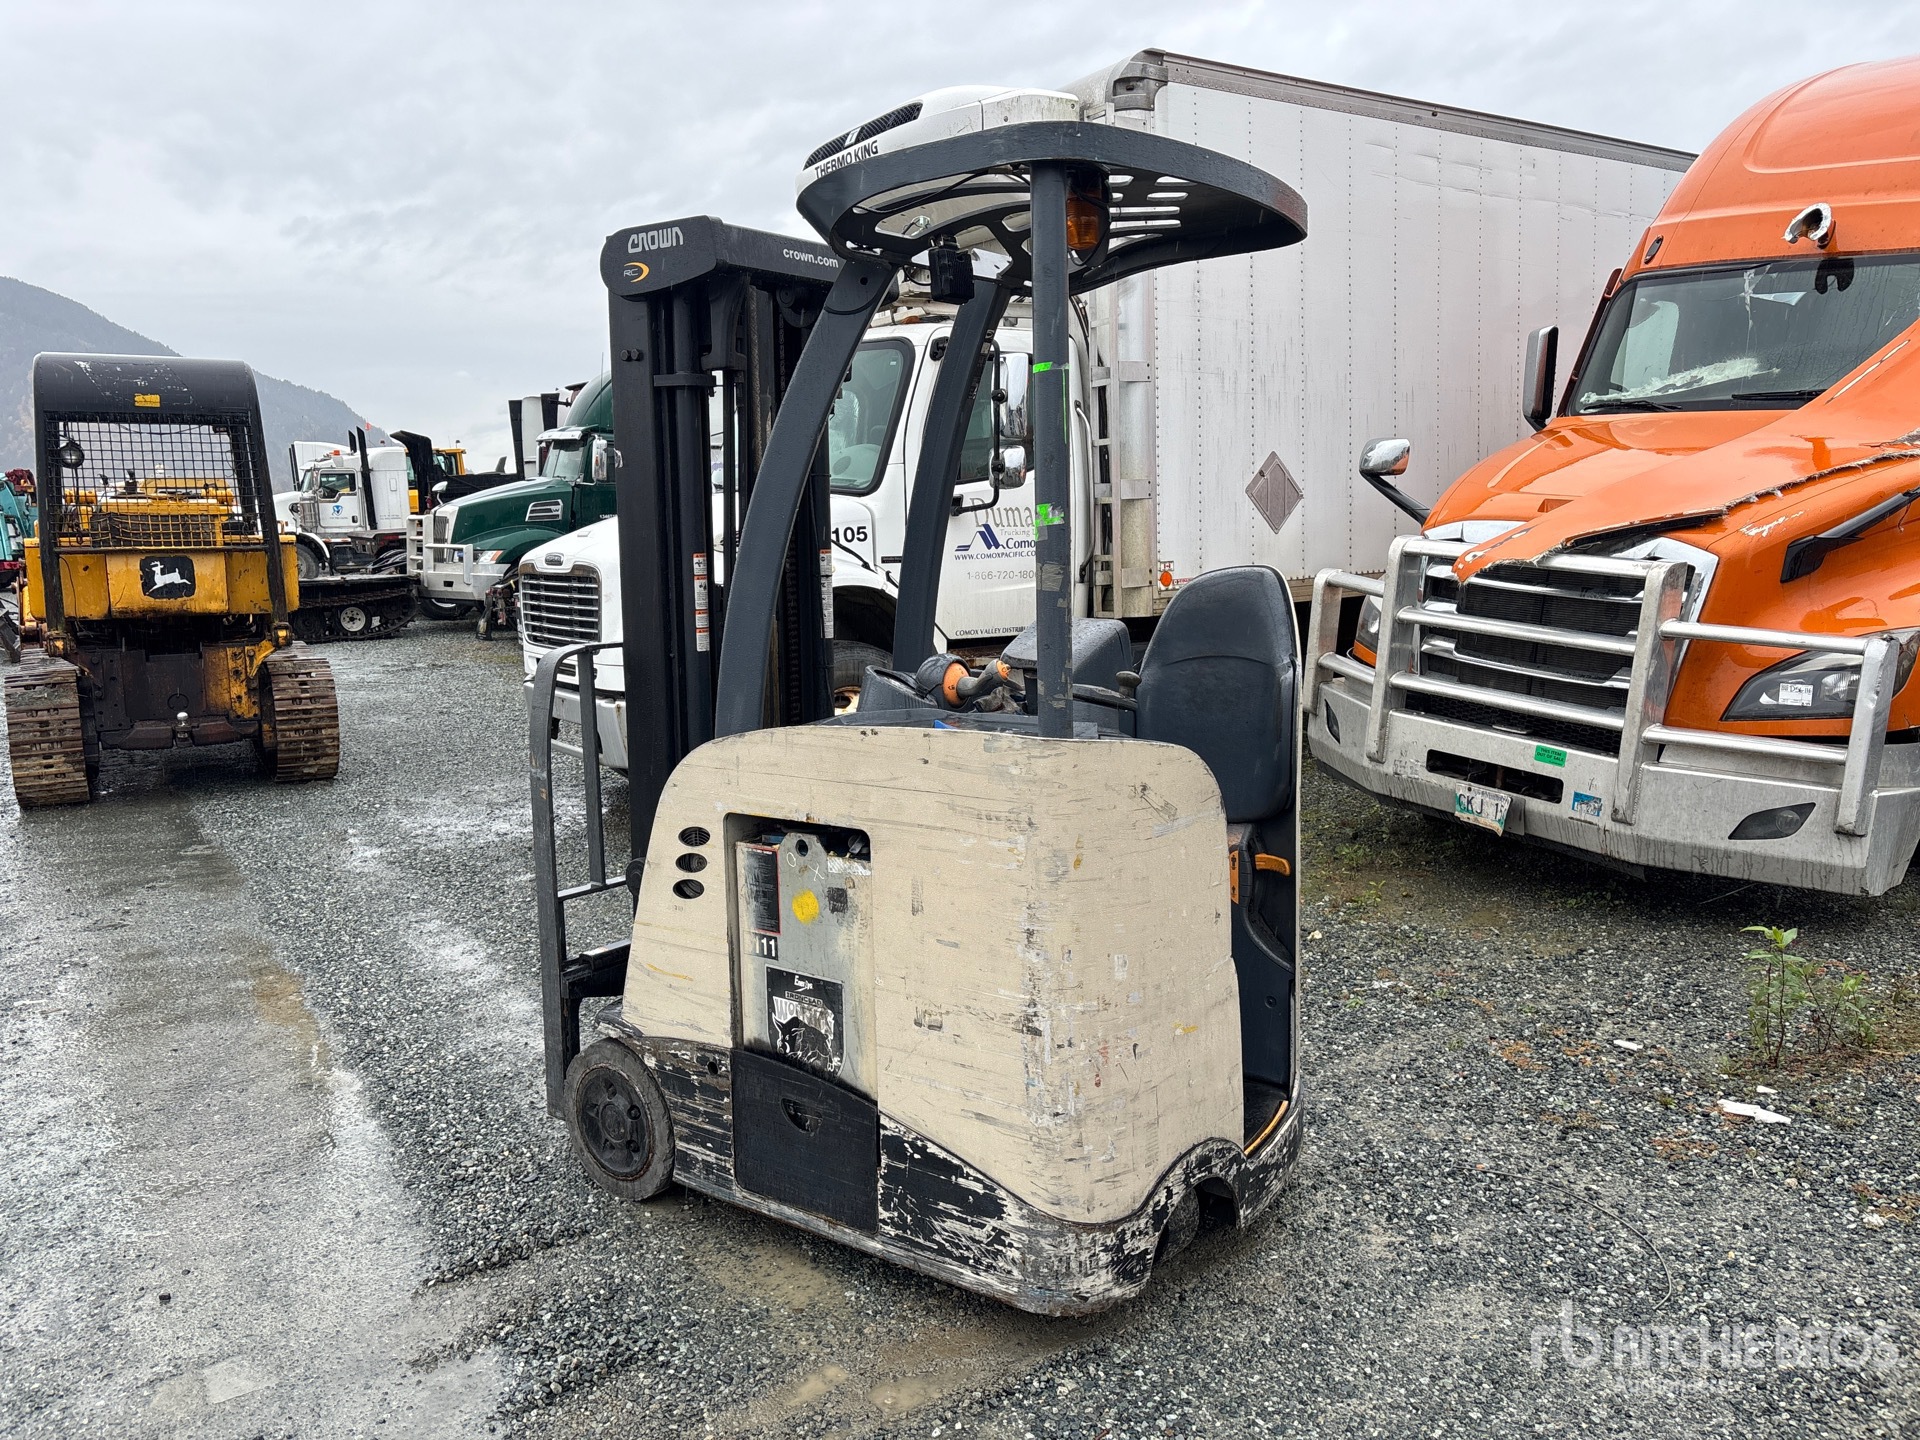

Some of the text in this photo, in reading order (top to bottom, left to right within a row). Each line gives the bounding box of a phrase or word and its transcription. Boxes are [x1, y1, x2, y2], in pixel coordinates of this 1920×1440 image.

[814, 139, 879, 179] THERMO KING
[627, 226, 684, 254] CROWN
[782, 248, 839, 269] crown.com
[623, 268, 639, 278] RC
[969, 497, 1035, 528] Duma
[831, 525, 868, 543] 105
[1000, 528, 1031, 538] Trucking
[1005, 537, 1036, 550] Como
[954, 550, 1036, 561] WWW.COMOXPACIFIC.CO
[966, 569, 1036, 580] 1-866-720-180
[955, 628, 979, 637] COMOX
[980, 627, 1002, 635] VALLEY
[786, 990, 823, 1006] IRONCLAD
